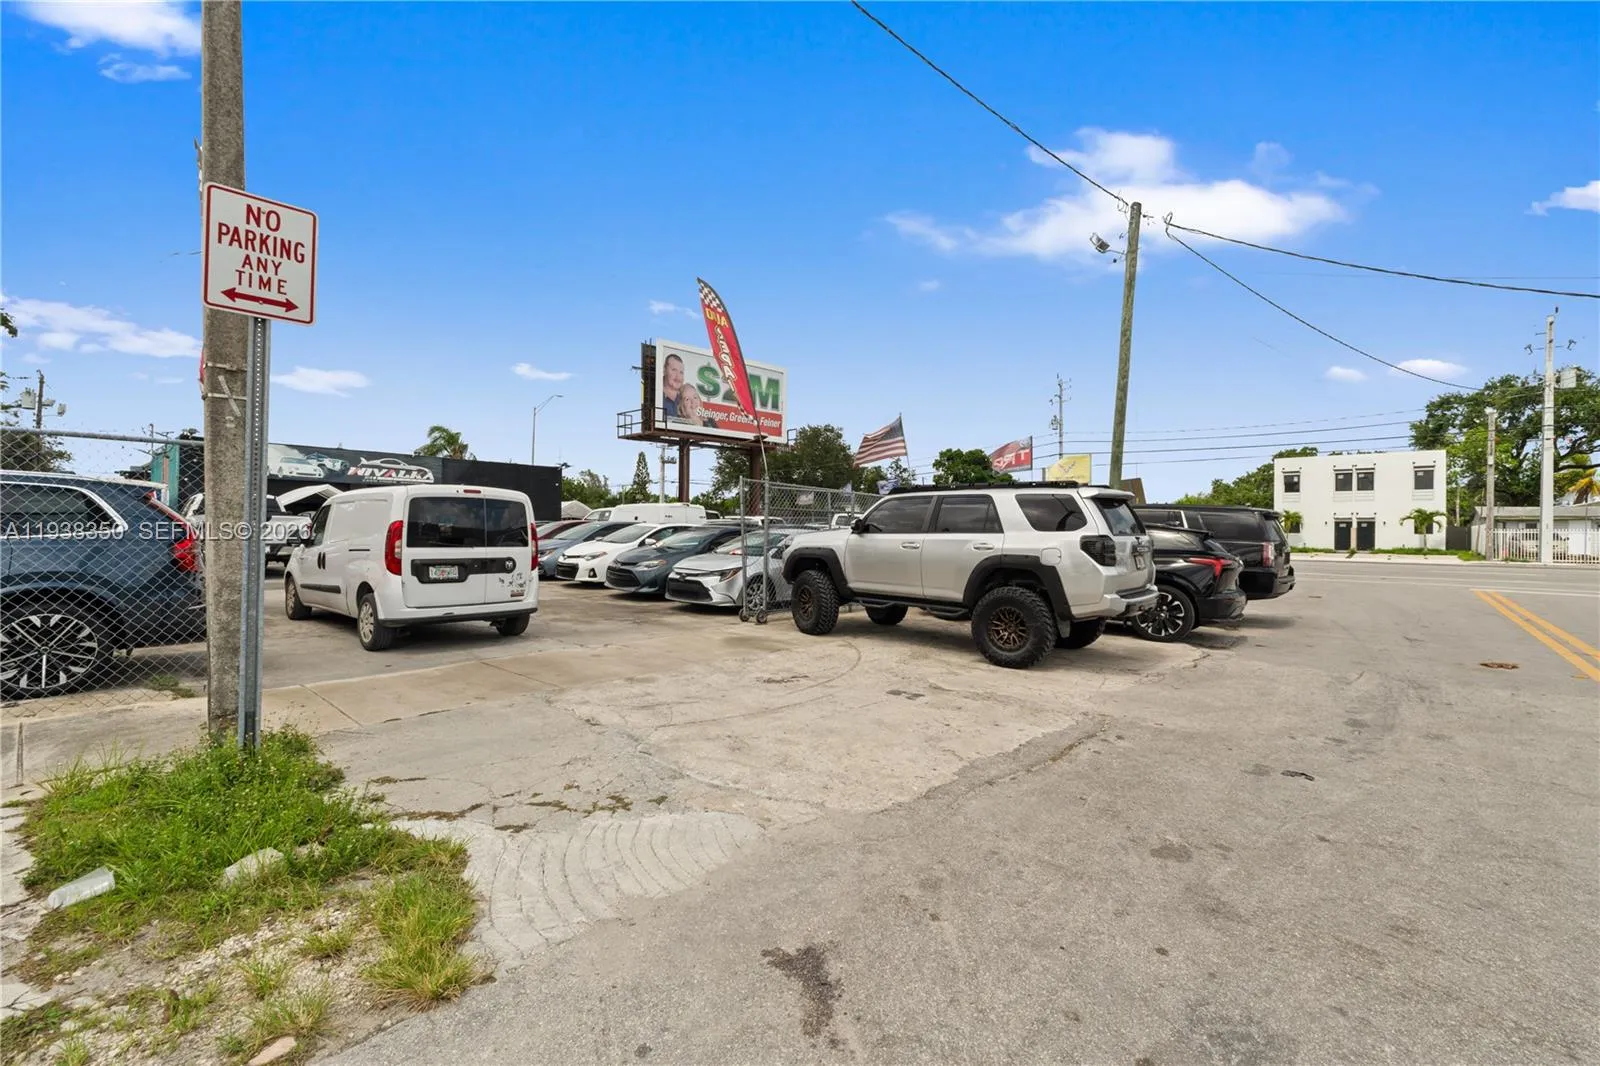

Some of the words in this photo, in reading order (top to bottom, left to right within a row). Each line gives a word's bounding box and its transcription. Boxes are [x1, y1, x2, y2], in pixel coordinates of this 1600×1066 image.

[245, 203, 281, 233] NO
[217, 222, 305, 264] PARKING
[241, 253, 282, 276] ANY
[235, 269, 287, 296] TIME
[696, 406, 729, 422] Steinger,
